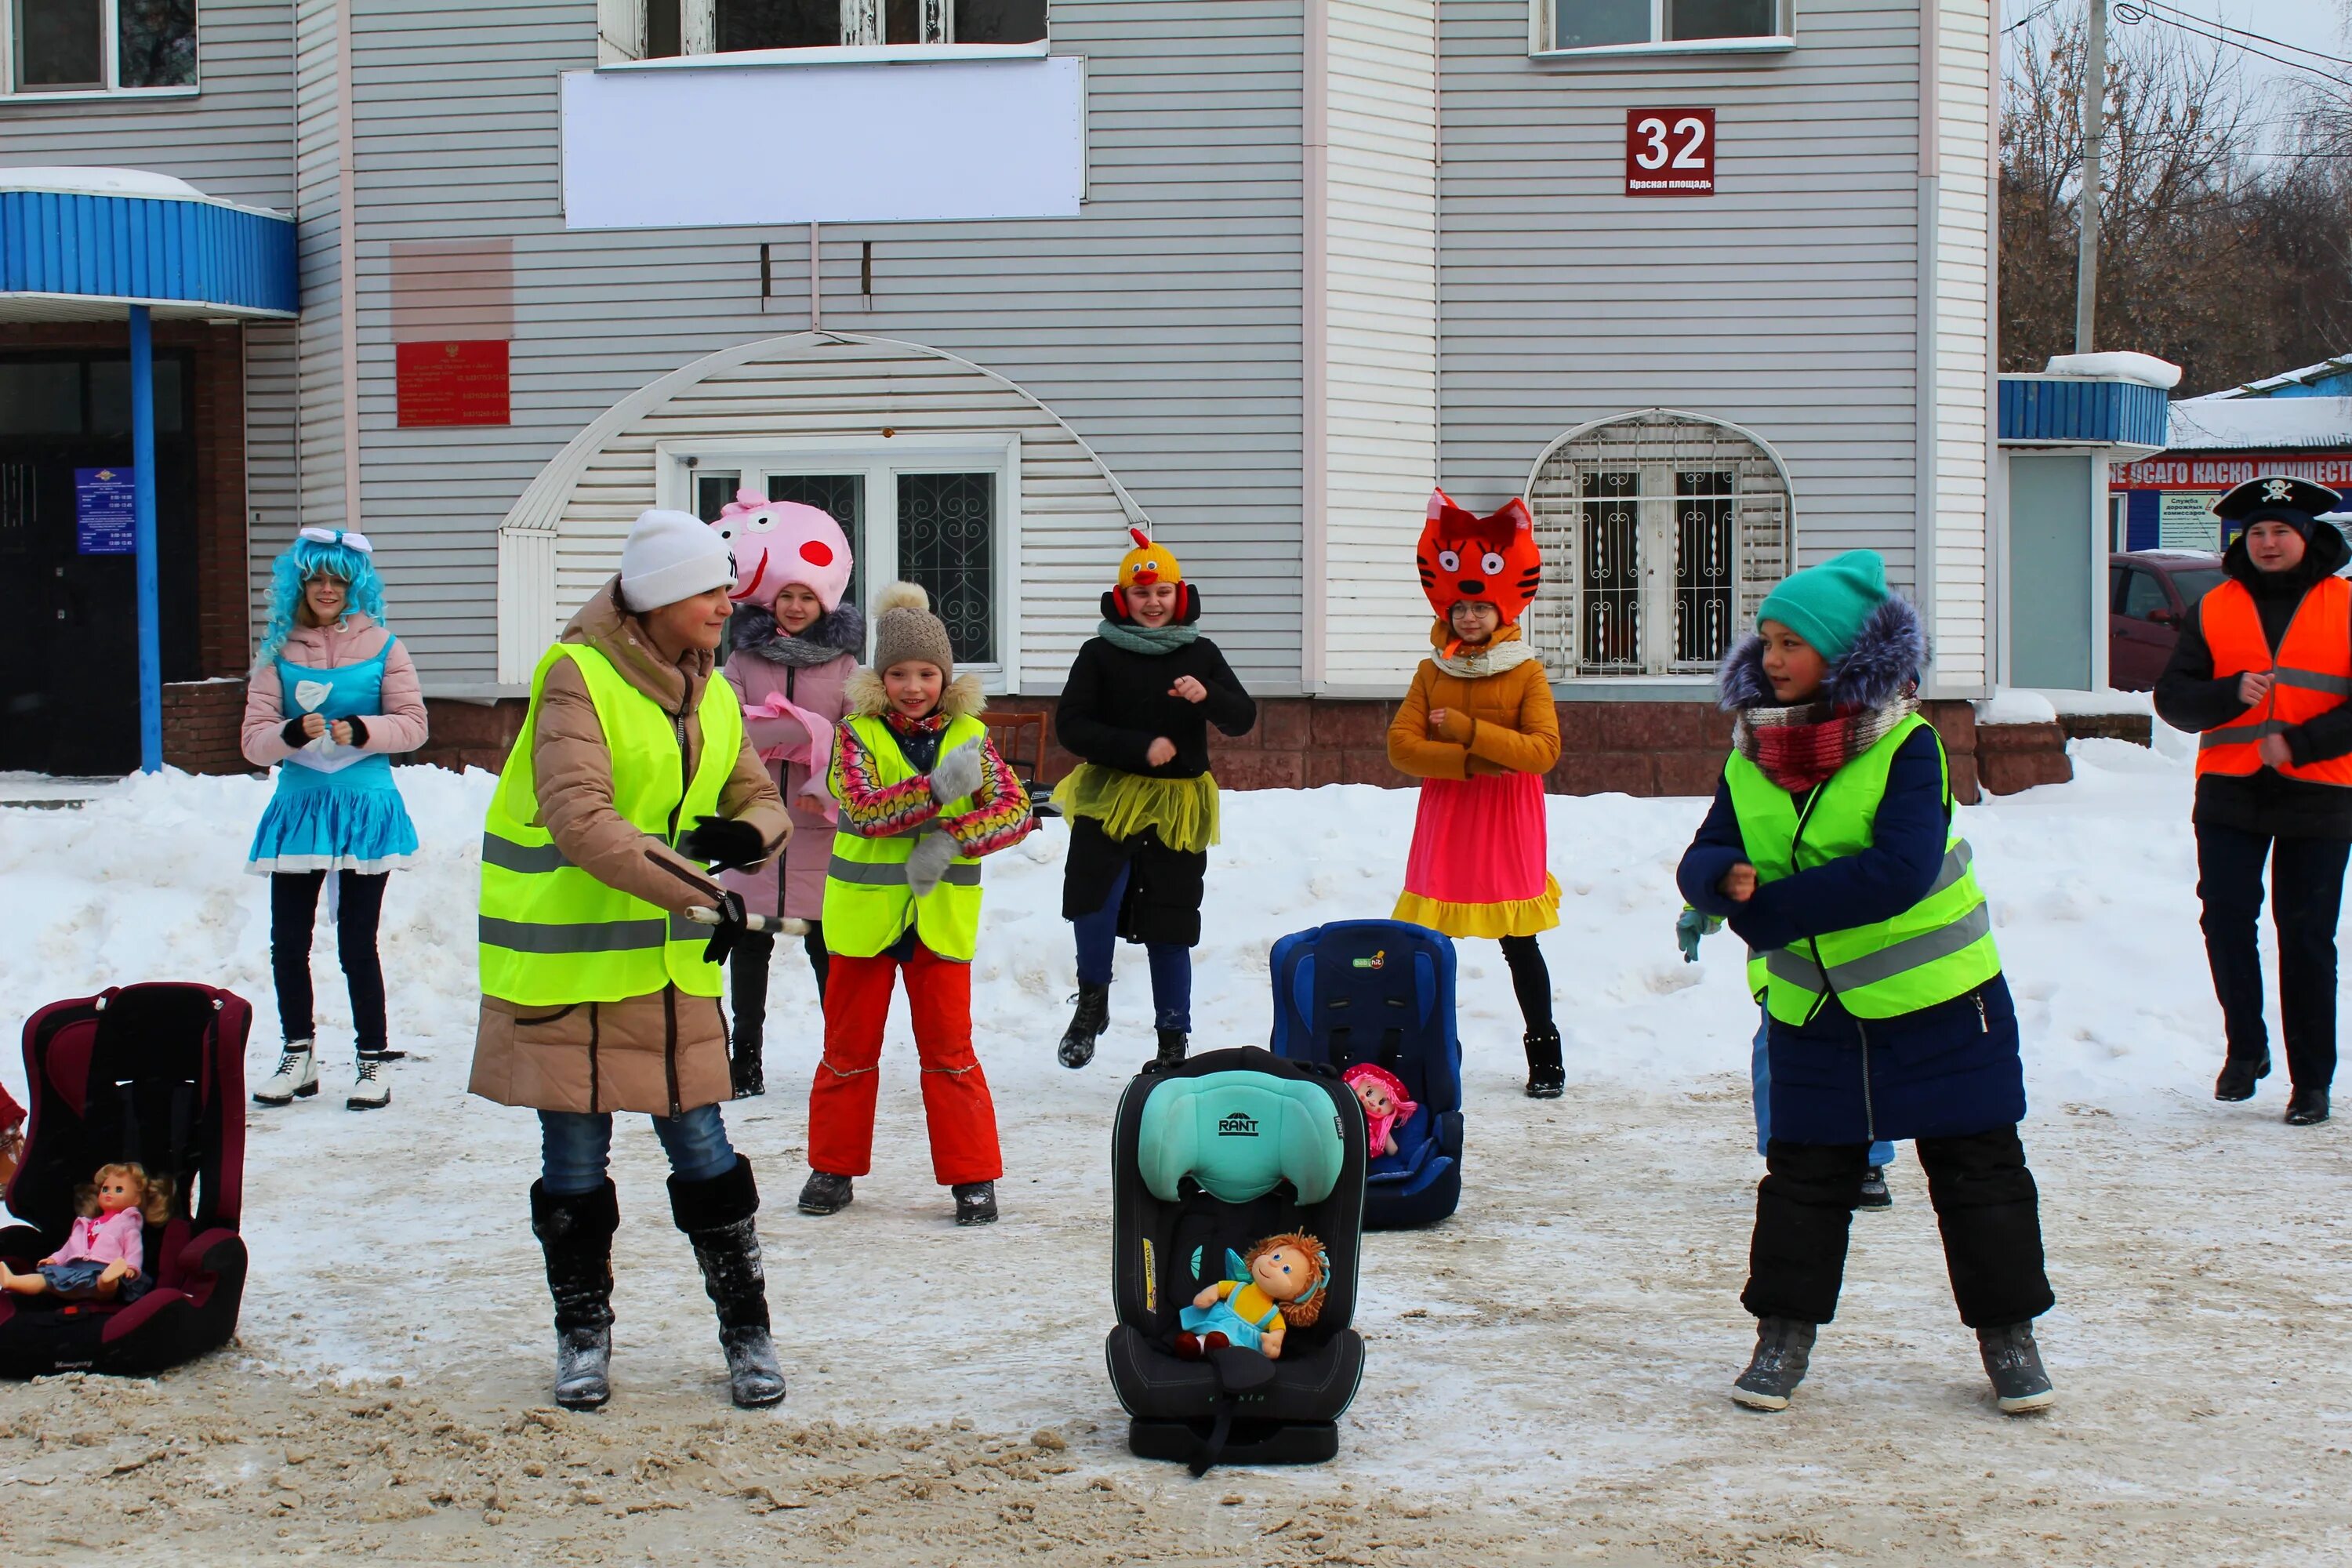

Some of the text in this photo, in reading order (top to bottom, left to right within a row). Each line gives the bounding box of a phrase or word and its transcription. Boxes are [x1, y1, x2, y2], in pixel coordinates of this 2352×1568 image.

[1635, 118, 1706, 169] 32
[1629, 180, 1711, 189] Красная площадь
[2130, 463, 2188, 484] ОСАГО
[2193, 462, 2253, 484] КАСКО
[1218, 1120, 1259, 1132] RANT
[1334, 1116, 1344, 1138] RANT
